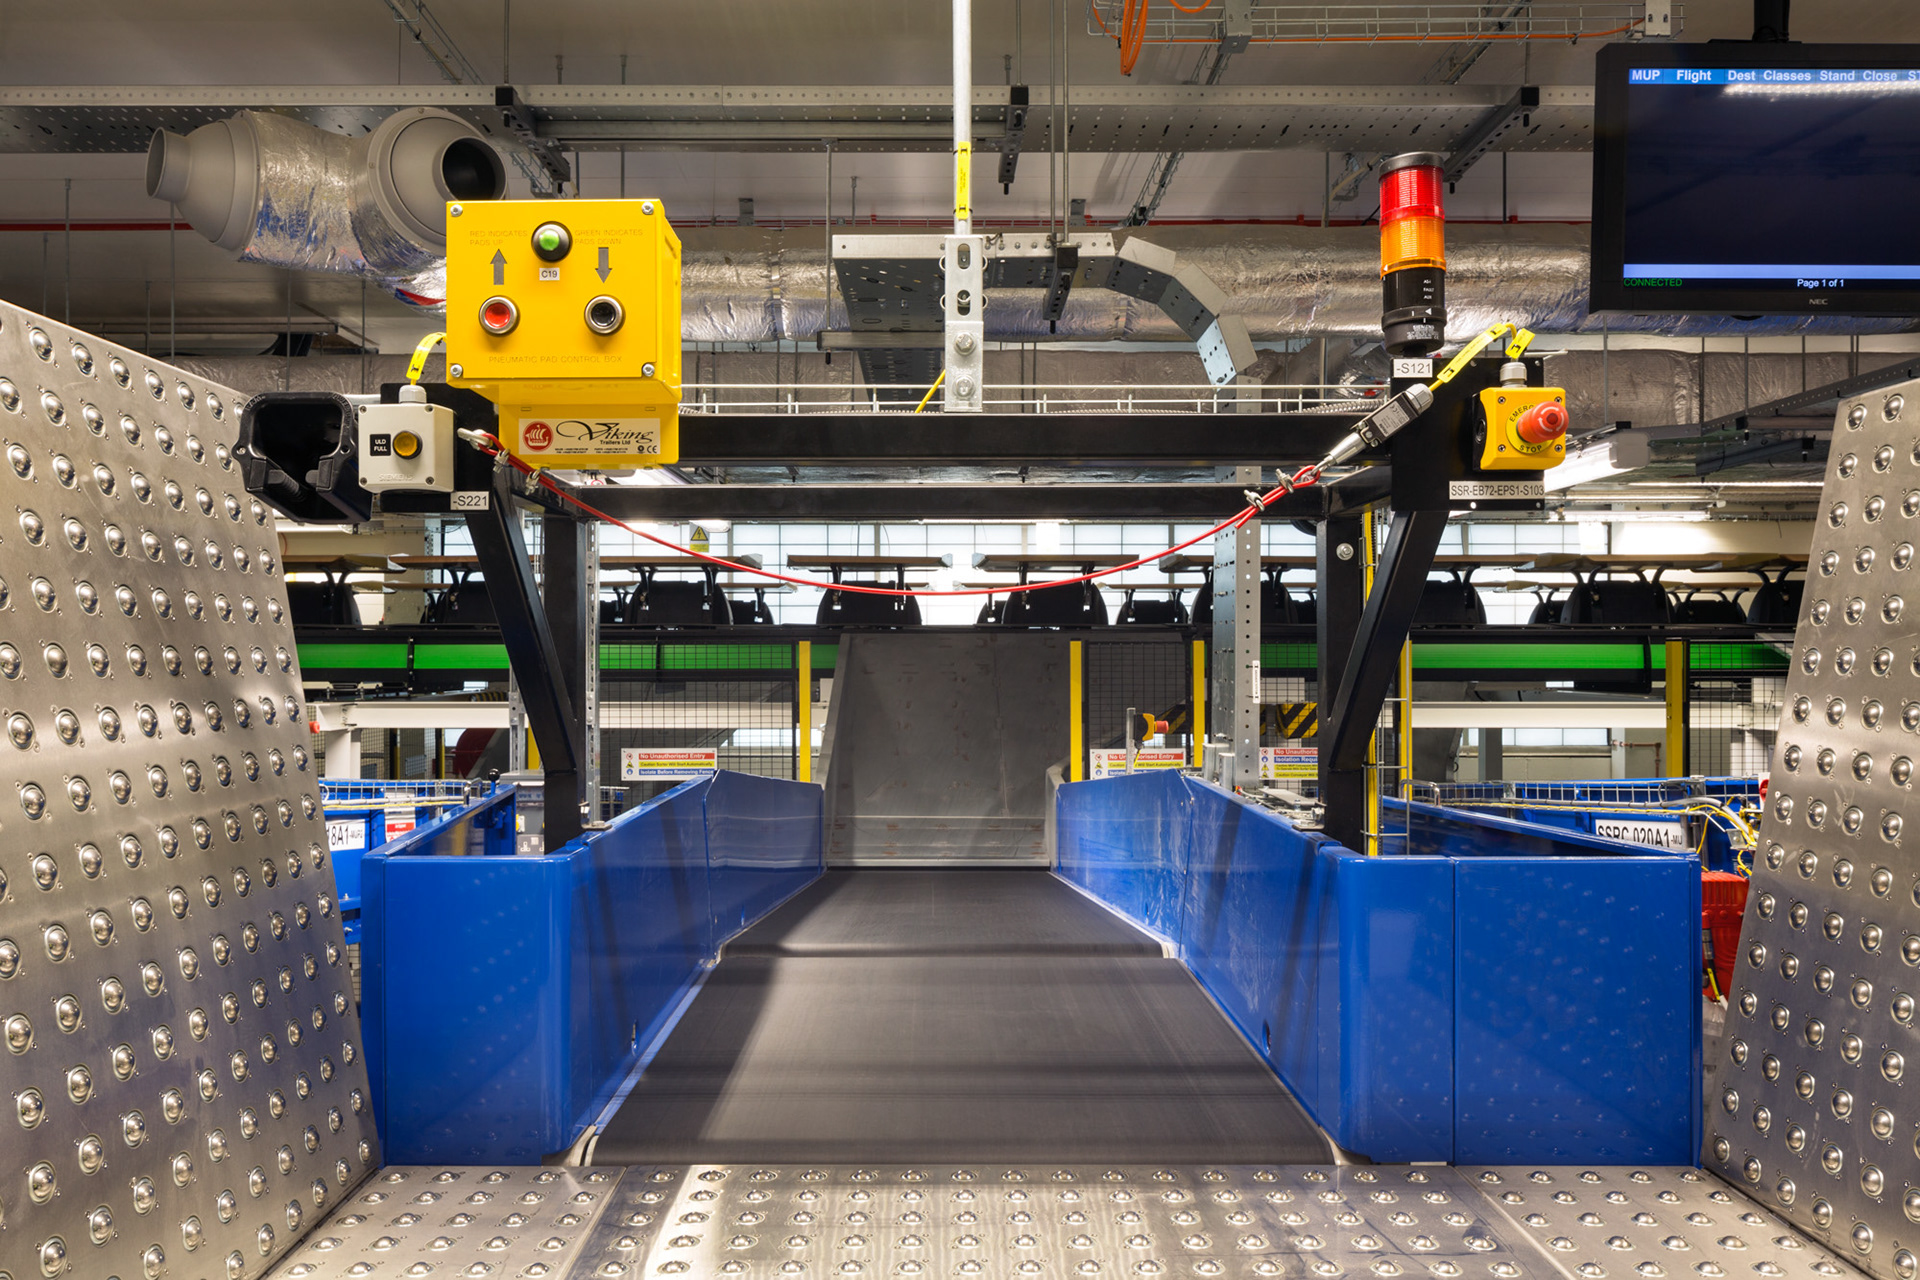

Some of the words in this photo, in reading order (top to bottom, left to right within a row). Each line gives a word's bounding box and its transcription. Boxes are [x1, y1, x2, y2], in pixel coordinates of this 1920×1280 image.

[1631, 70, 1660, 81] MUP
[1676, 70, 1711, 83] Flight
[1727, 70, 1756, 81] Dest
[1763, 70, 1811, 81] Classes
[1819, 70, 1855, 81] Stand
[1862, 70, 1897, 81] Close
[469, 230, 486, 238] RED
[488, 230, 528, 238] INDICATES
[574, 229, 601, 237] GREEN
[604, 228, 643, 237] INDICATES
[574, 238, 594, 246] PADS
[541, 270, 558, 278] C19
[1623, 278, 1683, 287] CONNECTED
[1797, 279, 1819, 289] Page
[1828, 278, 1839, 287] of
[488, 356, 536, 364] PNEUMATIC
[560, 355, 601, 363] CONTROL
[604, 355, 622, 363] BOX
[1396, 362, 1431, 374] -S121
[556, 420, 653, 444] Viking
[1519, 444, 1542, 453] STOP
[379, 473, 414, 482] SIEMENS
[1450, 485, 1545, 496] SSR-EB72-EPS1-S103
[453, 495, 487, 506] -S221
